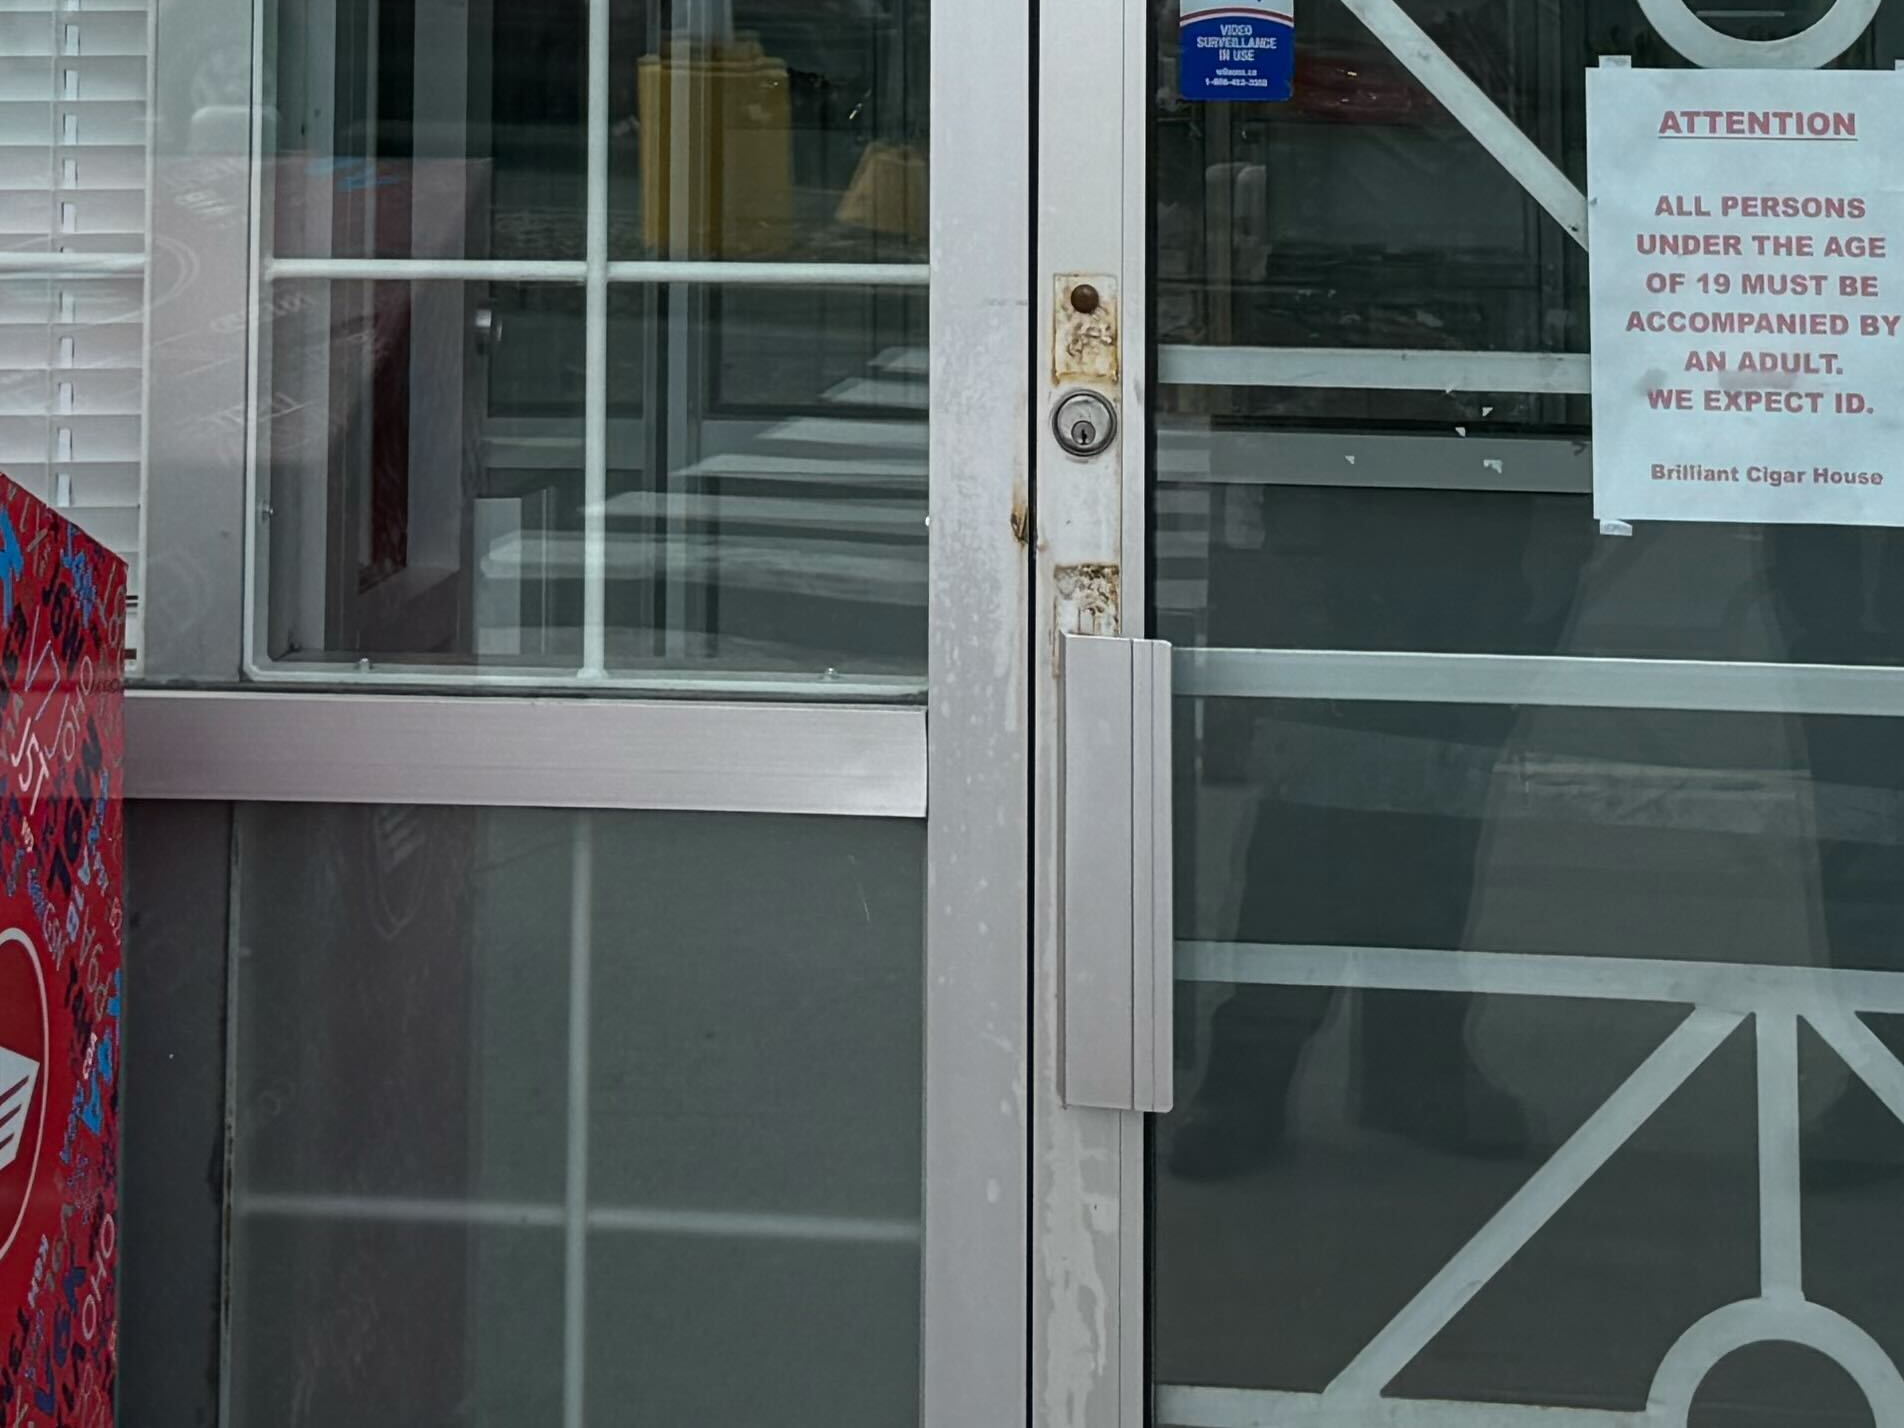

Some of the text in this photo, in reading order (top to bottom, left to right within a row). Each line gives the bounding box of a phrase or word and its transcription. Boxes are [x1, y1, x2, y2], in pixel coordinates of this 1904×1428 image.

[1220, 24, 1252, 35] VIDEO
[1197, 36, 1277, 49] SURVEILLANCE
[1219, 49, 1255, 61] IN USE
[1657, 110, 1857, 137] ATTENTION
[1654, 195, 1866, 219] ALL PERSONS
[1636, 234, 1887, 259] UNDER THE AGE
[1645, 273, 1879, 297] OF 19 MUST BE
[1625, 311, 1901, 337] ACCOMPANIED BY
[1684, 351, 1843, 375] AN ADULT.
[1647, 389, 1874, 414] WE EXPECT ID.
[1650, 464, 1883, 487] Brilliant Cigar House
[24, 604, 70, 760] V7J
[11, 717, 50, 816] J5T
